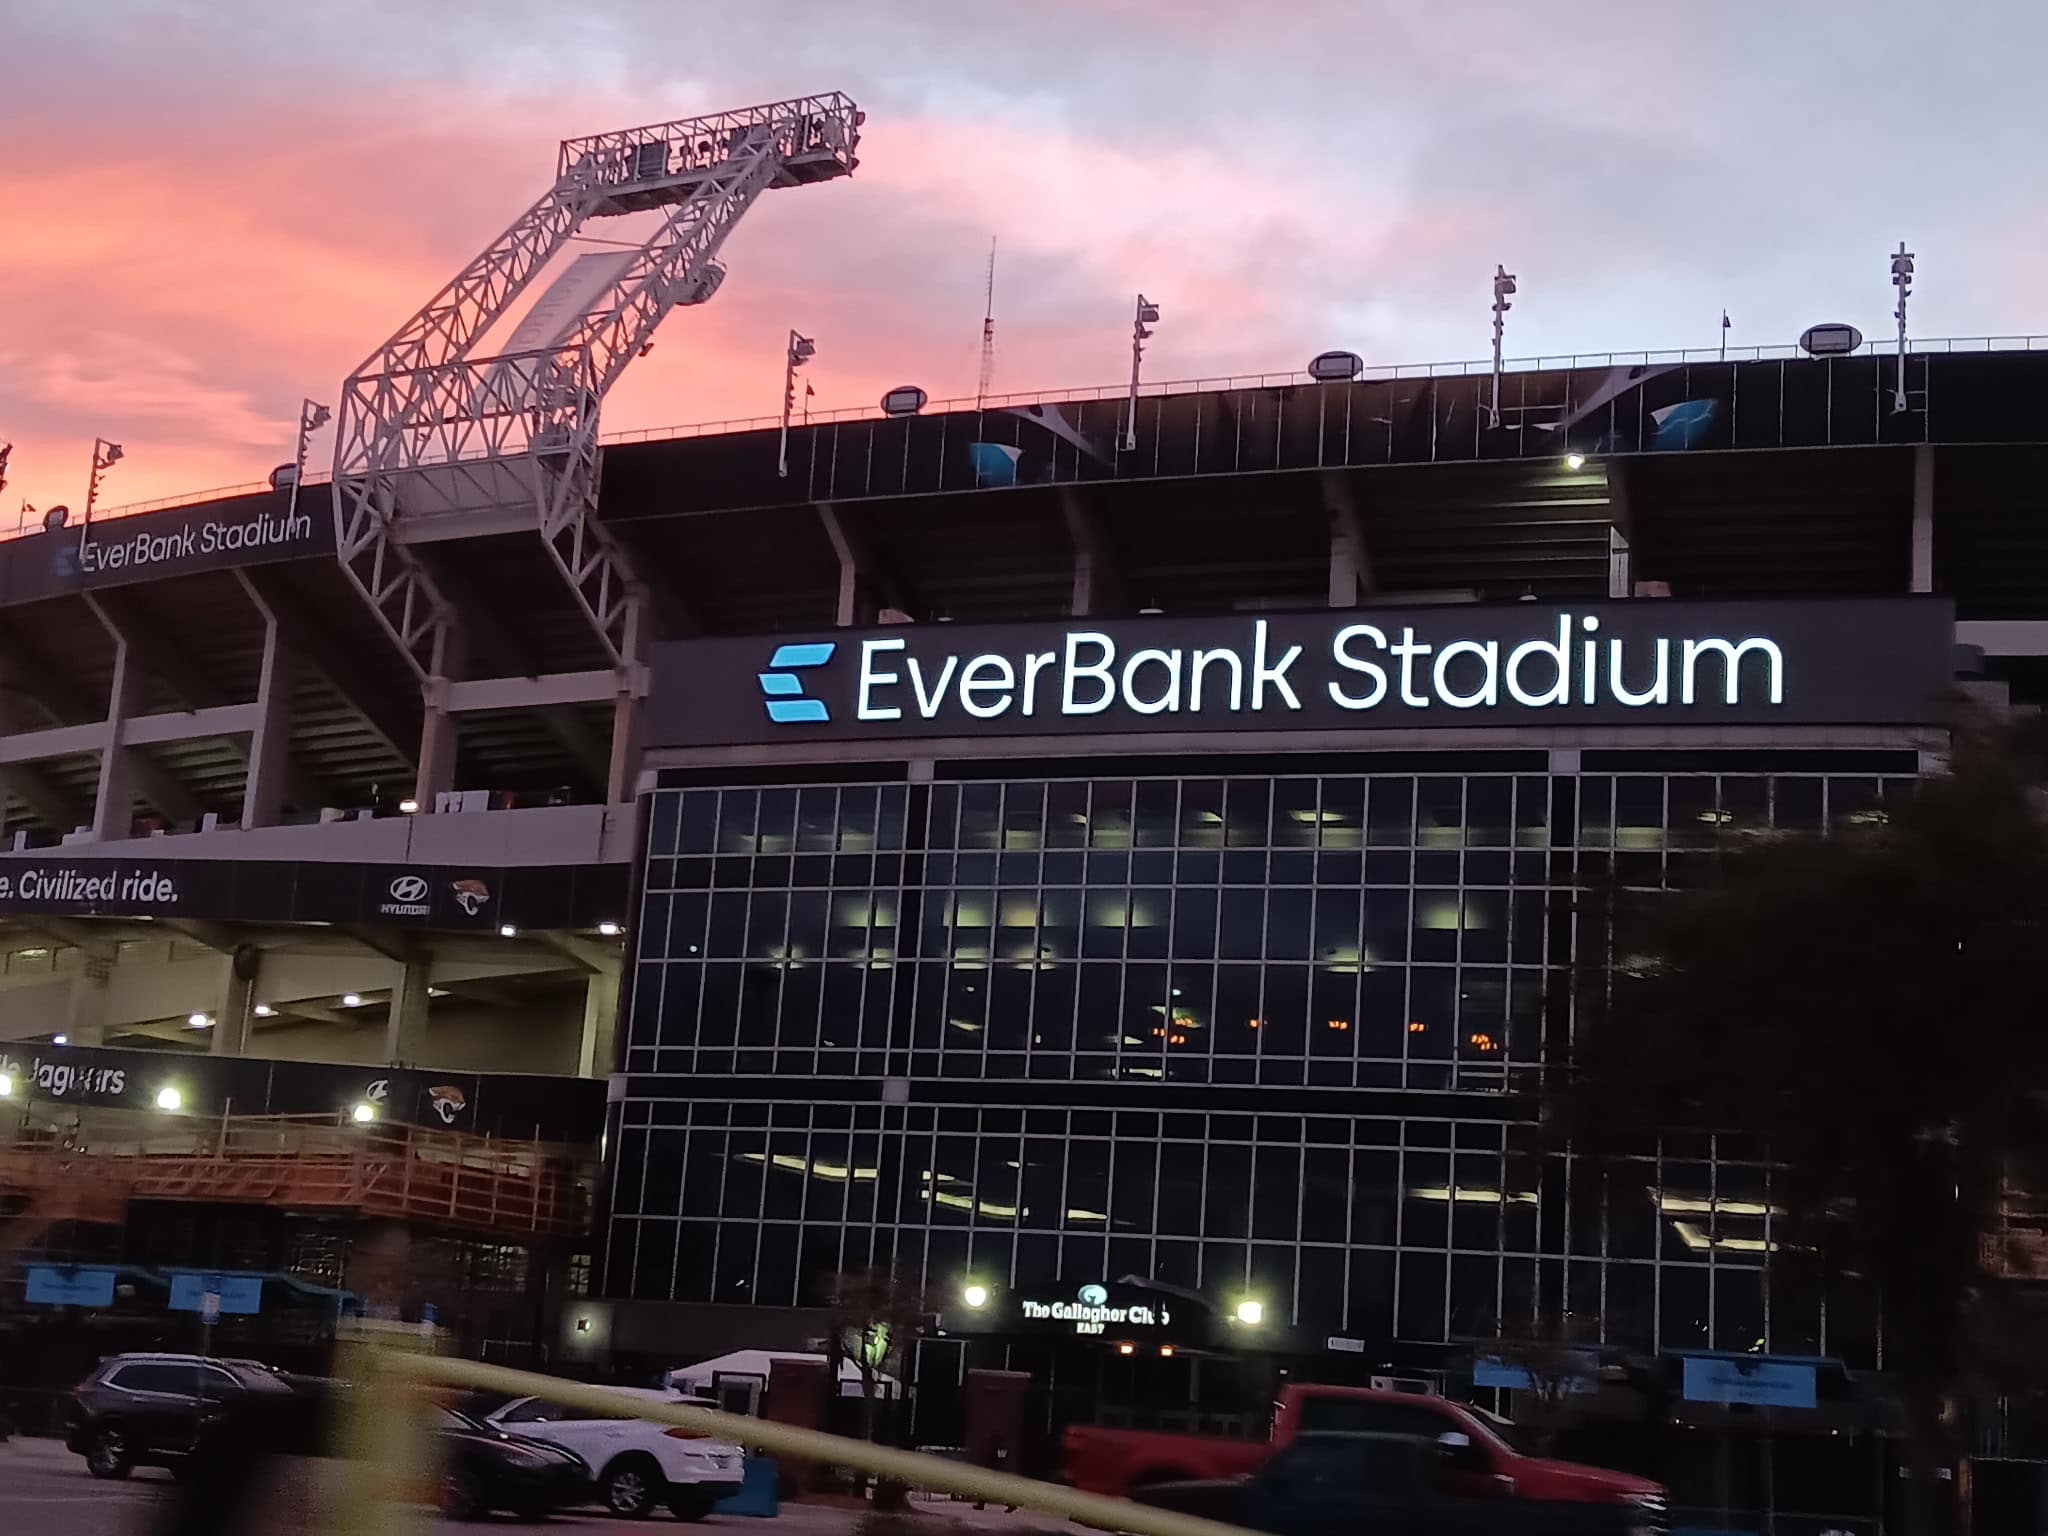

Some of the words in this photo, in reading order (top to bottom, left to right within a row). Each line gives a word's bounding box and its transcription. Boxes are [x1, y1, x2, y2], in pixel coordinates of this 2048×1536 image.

[83, 524, 195, 572] EverBank
[200, 513, 311, 553] Stadium
[857, 619, 1302, 721] EverBank
[1328, 613, 1783, 710] Stadium
[19, 868, 118, 900] Civilized
[121, 869, 178, 902] ride.
[1022, 1300, 1050, 1319] The
[1051, 1301, 1127, 1323] Gallagher
